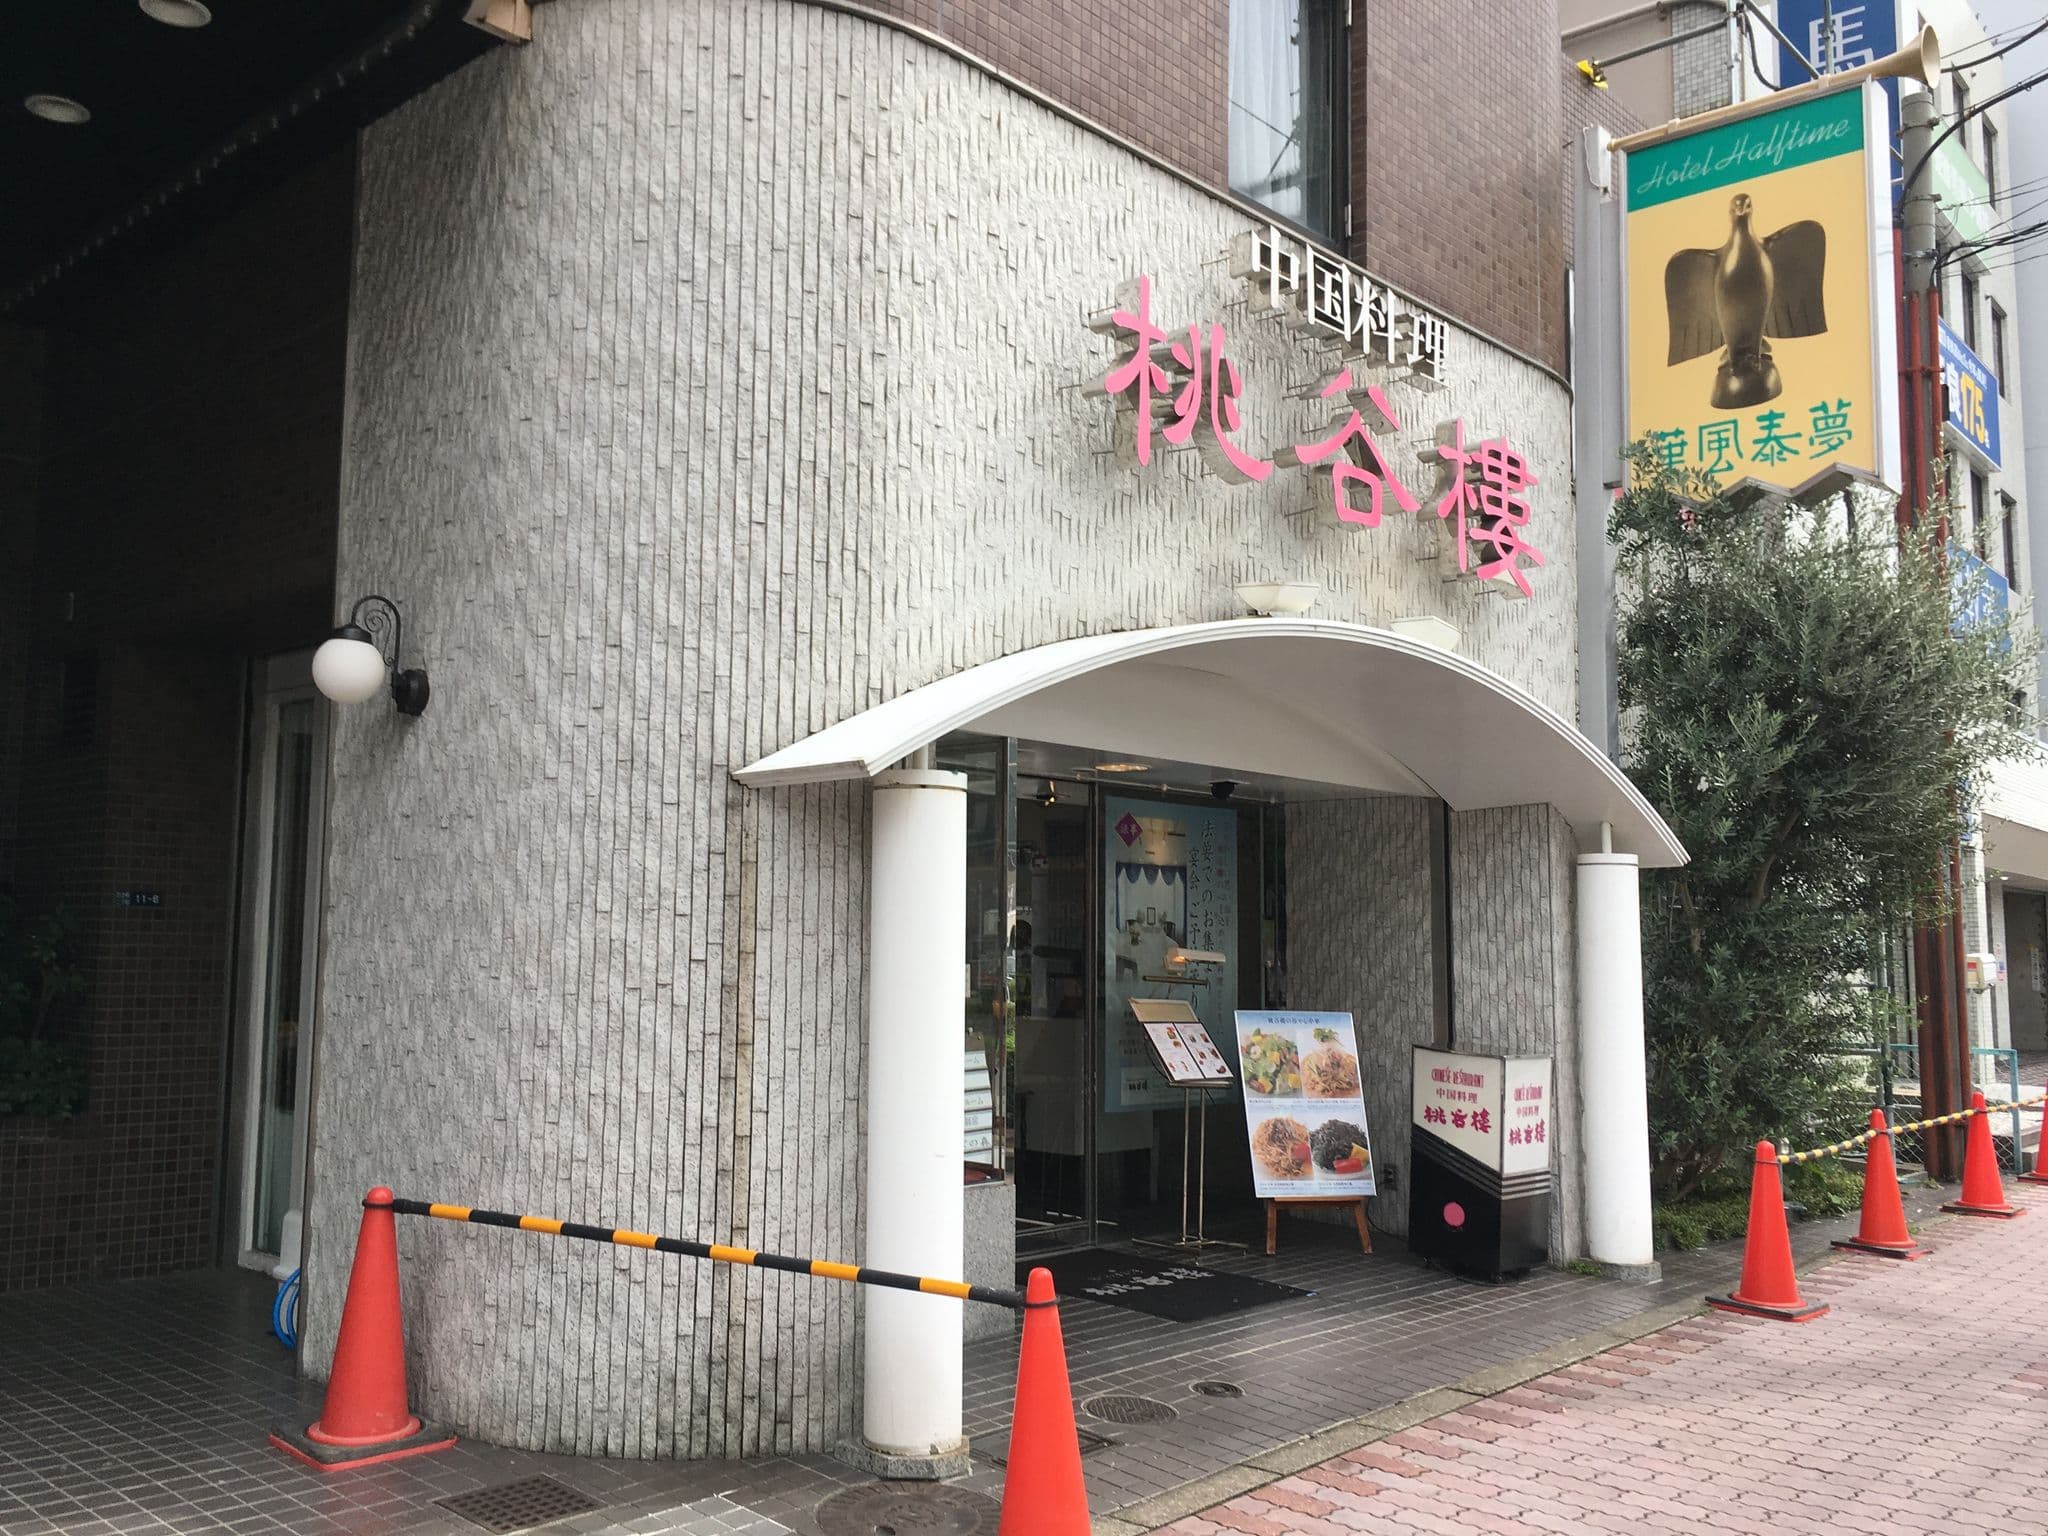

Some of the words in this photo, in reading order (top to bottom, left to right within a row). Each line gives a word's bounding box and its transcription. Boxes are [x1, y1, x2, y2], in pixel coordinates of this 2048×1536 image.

[1637, 147, 1711, 194] Hotel
[1715, 119, 1849, 170] Halftime
[1251, 225, 1450, 384] 中国料理
[1105, 274, 1546, 598] 桃谷樓
[1188, 849, 1201, 1011] 宴会ご予承り
[1436, 1087, 1478, 1104] 中国料理
